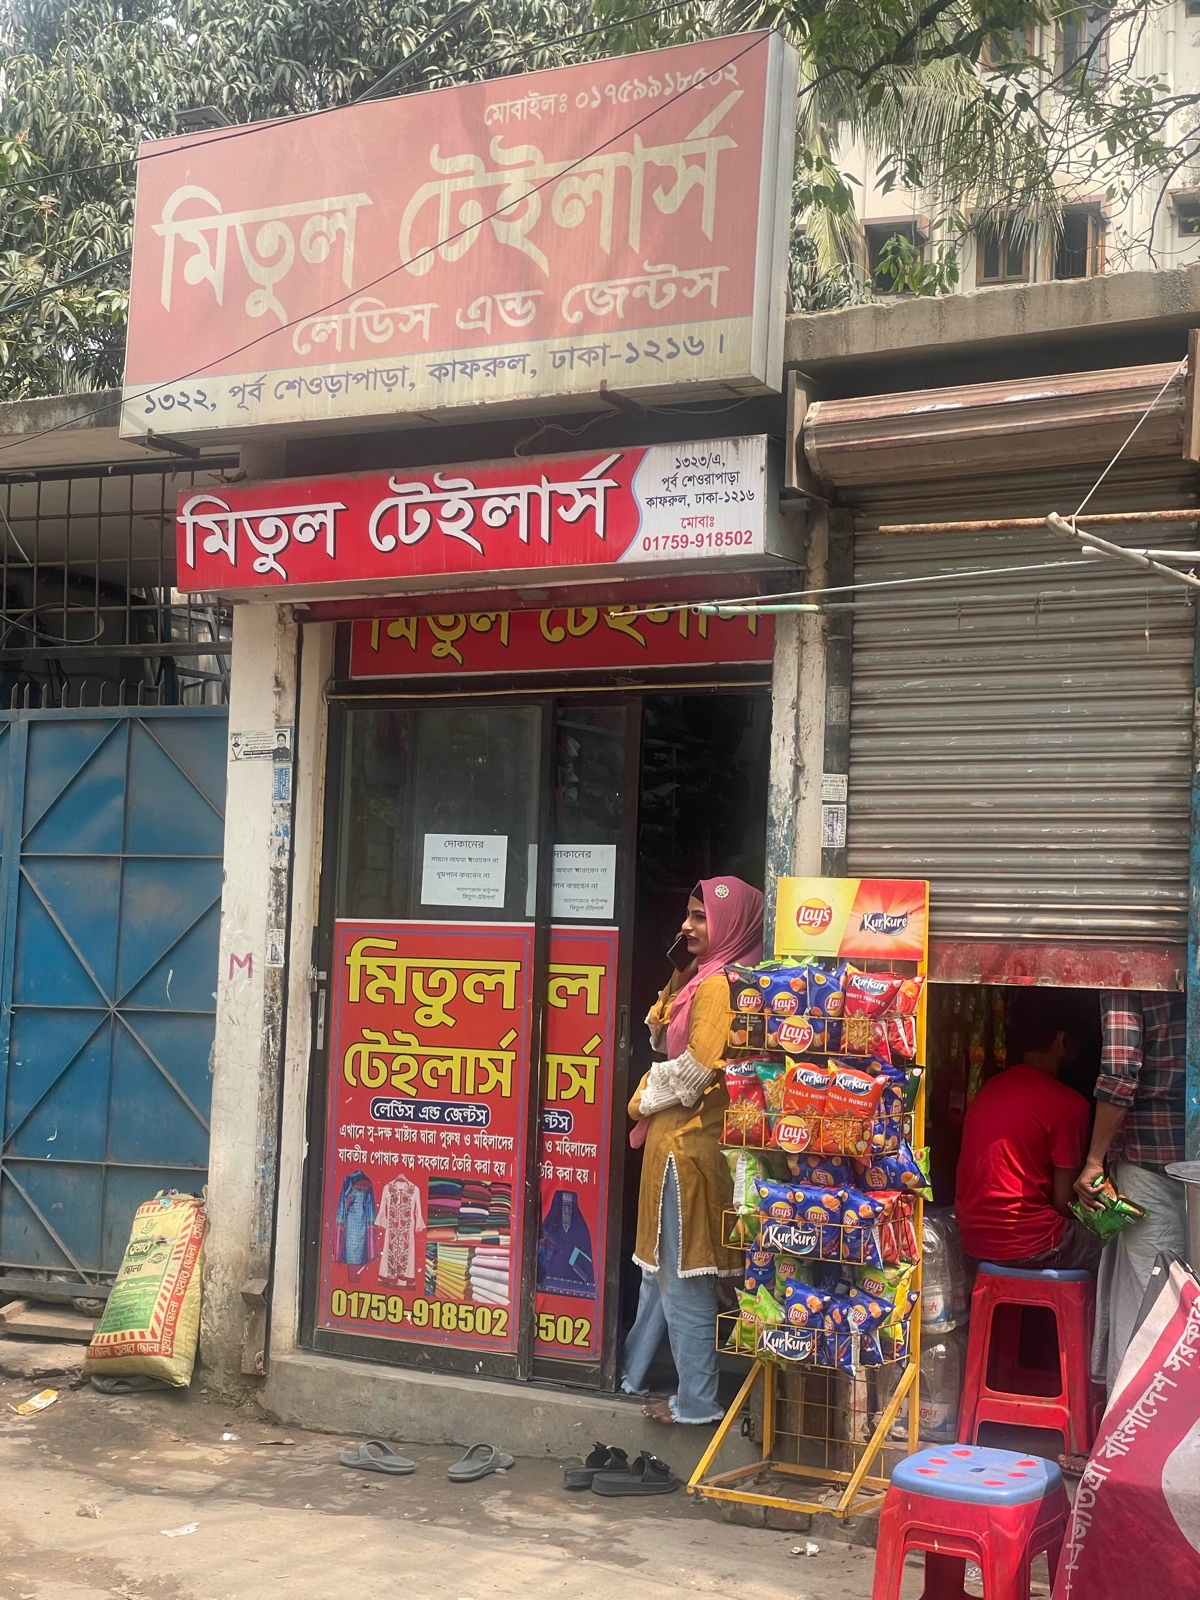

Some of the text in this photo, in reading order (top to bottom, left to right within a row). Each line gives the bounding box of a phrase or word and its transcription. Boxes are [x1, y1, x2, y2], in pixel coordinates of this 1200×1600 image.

[151, 90, 745, 331] মিতুল টেইলার্স
[292, 260, 731, 356] লেডিস এন্ড জেন্টস
[228, 373, 269, 411] পূর্ব
[661, 470, 741, 493] পূর্ব শেওরাপাড়া
[176, 453, 624, 581] মিতুল টেইলার্স
[642, 529, 753, 551] 01759-918502
[443, 840, 485, 850] দোকানের
[798, 905, 831, 928] Lay's
[863, 912, 908, 934] Kurkure
[229, 952, 253, 980] M
[345, 936, 522, 1028] মিতুল
[851, 974, 889, 992] Kurkure
[779, 1024, 811, 1045] Lay's
[343, 1028, 518, 1098] টেইলার্স
[797, 1069, 830, 1086] Kurkur
[834, 1073, 873, 1091] Kurkure
[374, 1101, 488, 1125] লেডিস এন্ড জেন্টস
[339, 1123, 365, 1140] এখানে
[439, 1131, 461, 1149] পুরুষ
[464, 1133, 470, 1146] ও
[473, 1130, 514, 1151] মহিলাদের
[778, 1124, 808, 1145] Lay's
[545, 1136, 598, 1158] ও মহিলাদের
[338, 1144, 368, 1164] যাবতীয়
[370, 1149, 399, 1166] পোষাক
[417, 1154, 450, 1171] সহকারে
[451, 1152, 472, 1172] তৈরি
[474, 1159, 491, 1175] করা
[493, 1161, 506, 1177] হয়
[555, 1166, 573, 1183] করা
[767, 1226, 817, 1251] Kurkure
[331, 1289, 509, 1338] 01759-918502
[762, 1330, 811, 1353] Kurkure
[1097, 1371, 1178, 1459] বাংলাদেশ
